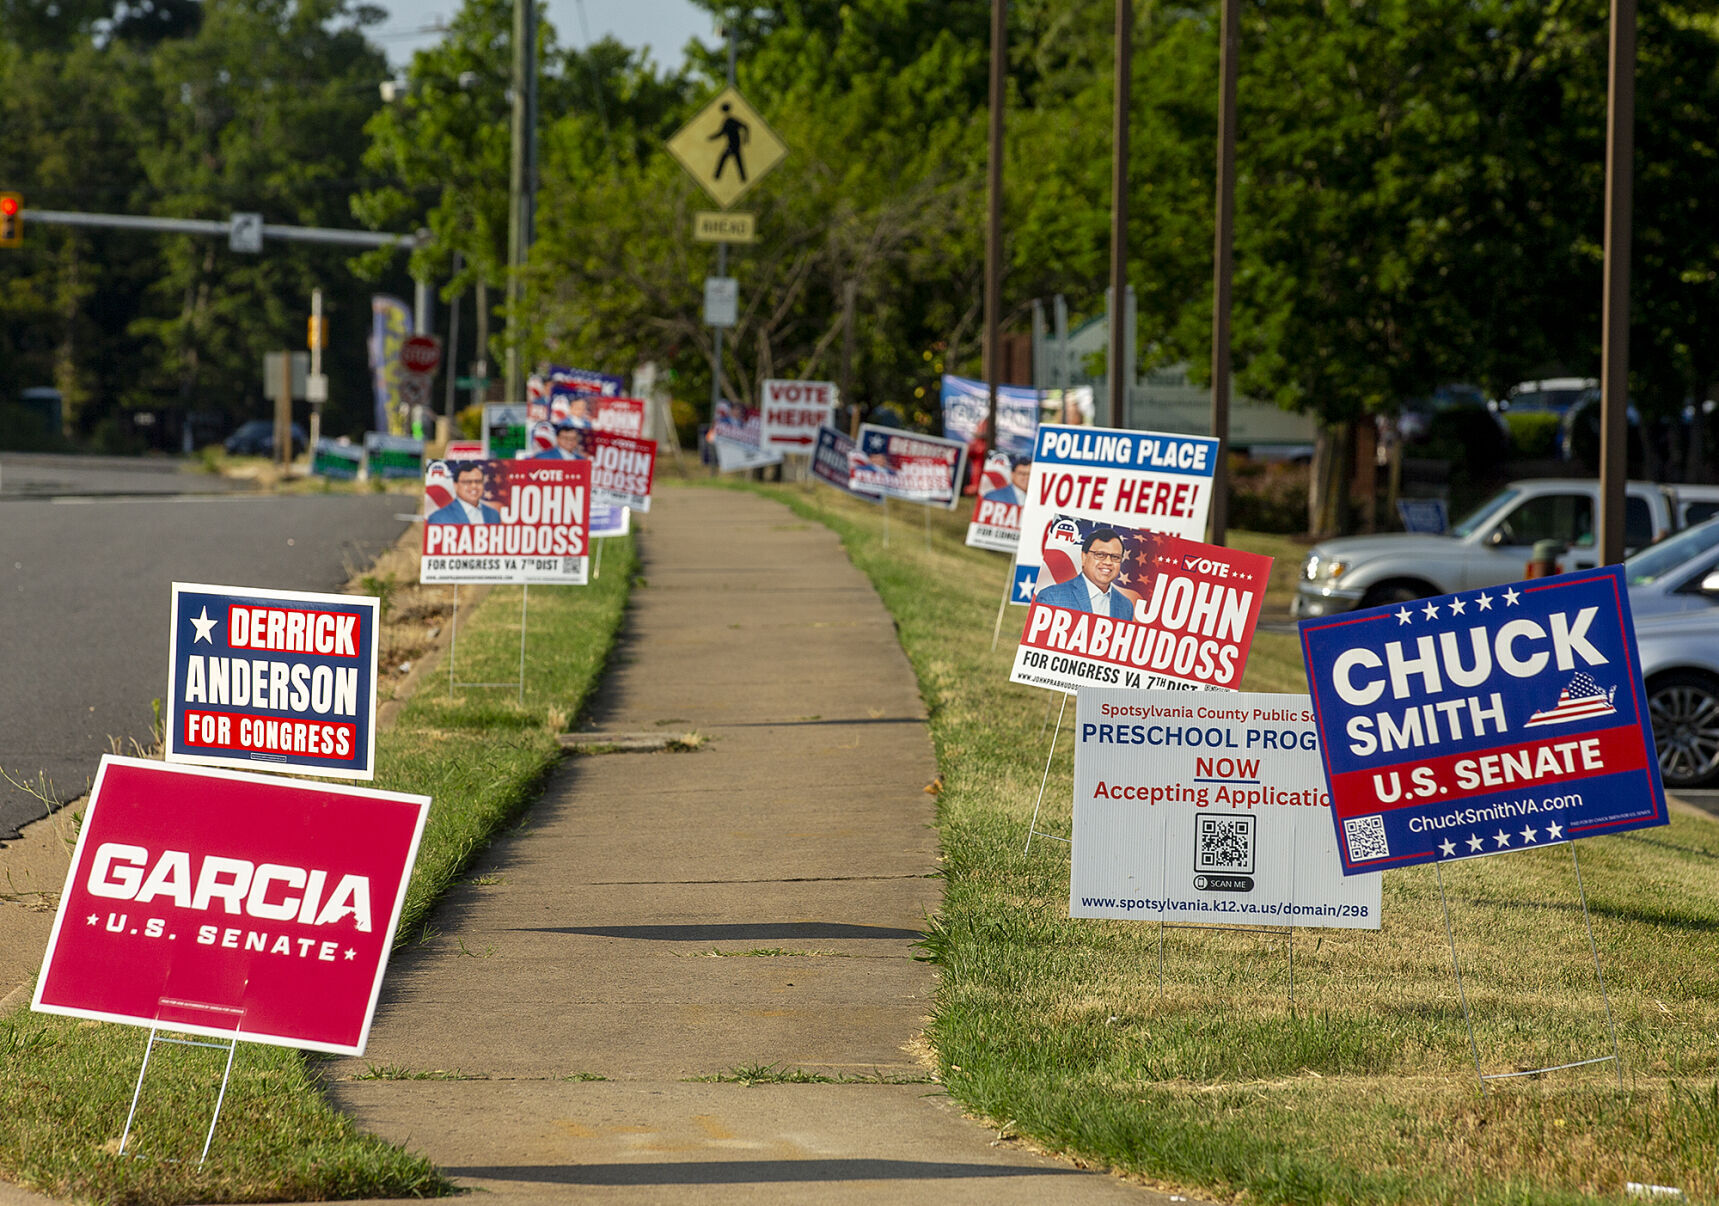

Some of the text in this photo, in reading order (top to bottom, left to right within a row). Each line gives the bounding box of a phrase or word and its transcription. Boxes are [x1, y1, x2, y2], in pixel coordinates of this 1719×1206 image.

[404, 349, 438, 363] STOP
[769, 385, 830, 404] VOTE
[767, 408, 827, 427] HERE
[590, 444, 652, 476] JOHN
[1041, 432, 1209, 470] POLLING PLACE
[529, 469, 563, 482] VOTE
[501, 485, 584, 524] JOHN
[1039, 472, 1199, 518] VOTE HERE!
[427, 525, 583, 555] PRABHUDOSS
[428, 559, 446, 570] FOR
[448, 559, 500, 571] CONGRESS
[505, 559, 517, 570] VA
[536, 559, 558, 570] DIST
[1183, 556, 1230, 578] VOTE
[1134, 573, 1253, 643] JOHN
[231, 607, 356, 656] DERRICK
[1027, 605, 1239, 684] PRABHUDOSS
[1023, 651, 1049, 669] FOR
[1051, 656, 1120, 684] CONGRESS
[1125, 671, 1140, 689] VA
[1332, 606, 1609, 706] CHUCK
[185, 655, 358, 716] ANDERSON
[1101, 703, 1193, 719] Spotsylvania
[1197, 706, 1249, 723] County
[1253, 708, 1297, 722] Public
[1346, 692, 1508, 756] SMITH
[188, 714, 350, 756] FOR CONGRESS
[1082, 723, 1238, 748] PRESCHOOL
[1196, 757, 1260, 779] NOW
[1373, 738, 1604, 803] U.S. SENATE
[1094, 781, 1208, 807] Accepting
[1409, 793, 1583, 833] ChuckSmithVA.com
[87, 842, 372, 933] GARCIA
[1210, 879, 1247, 888] SCAN ME
[1081, 896, 1369, 917] www.spotsylvania.k12.va.us/domain/298
[106, 912, 338, 961] U.S. SENATE
